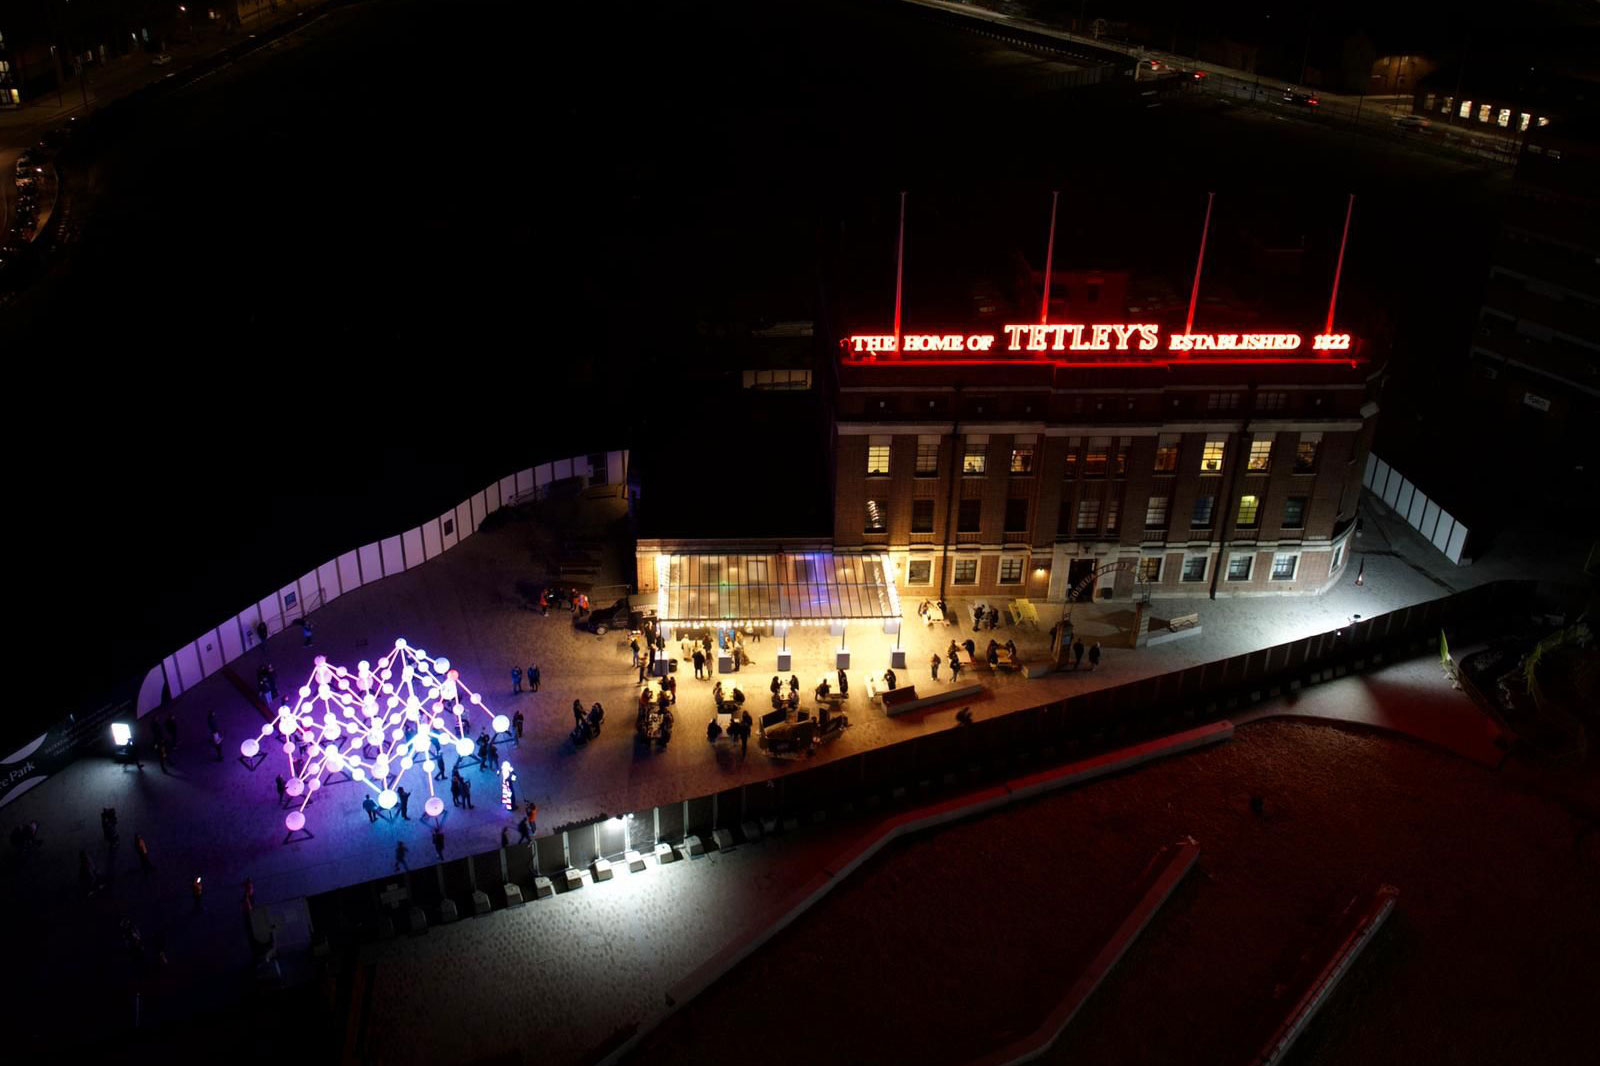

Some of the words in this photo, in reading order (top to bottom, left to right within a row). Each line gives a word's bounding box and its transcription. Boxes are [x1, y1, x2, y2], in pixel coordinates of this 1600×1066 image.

[850, 335, 897, 351] THE
[903, 335, 964, 351] HOME
[966, 335, 995, 351] OF
[1004, 323, 1159, 351] TETLEY'S
[1168, 334, 1301, 351] ESTABLISHED
[1312, 334, 1351, 350] 1822
[9, 760, 36, 782] Park
